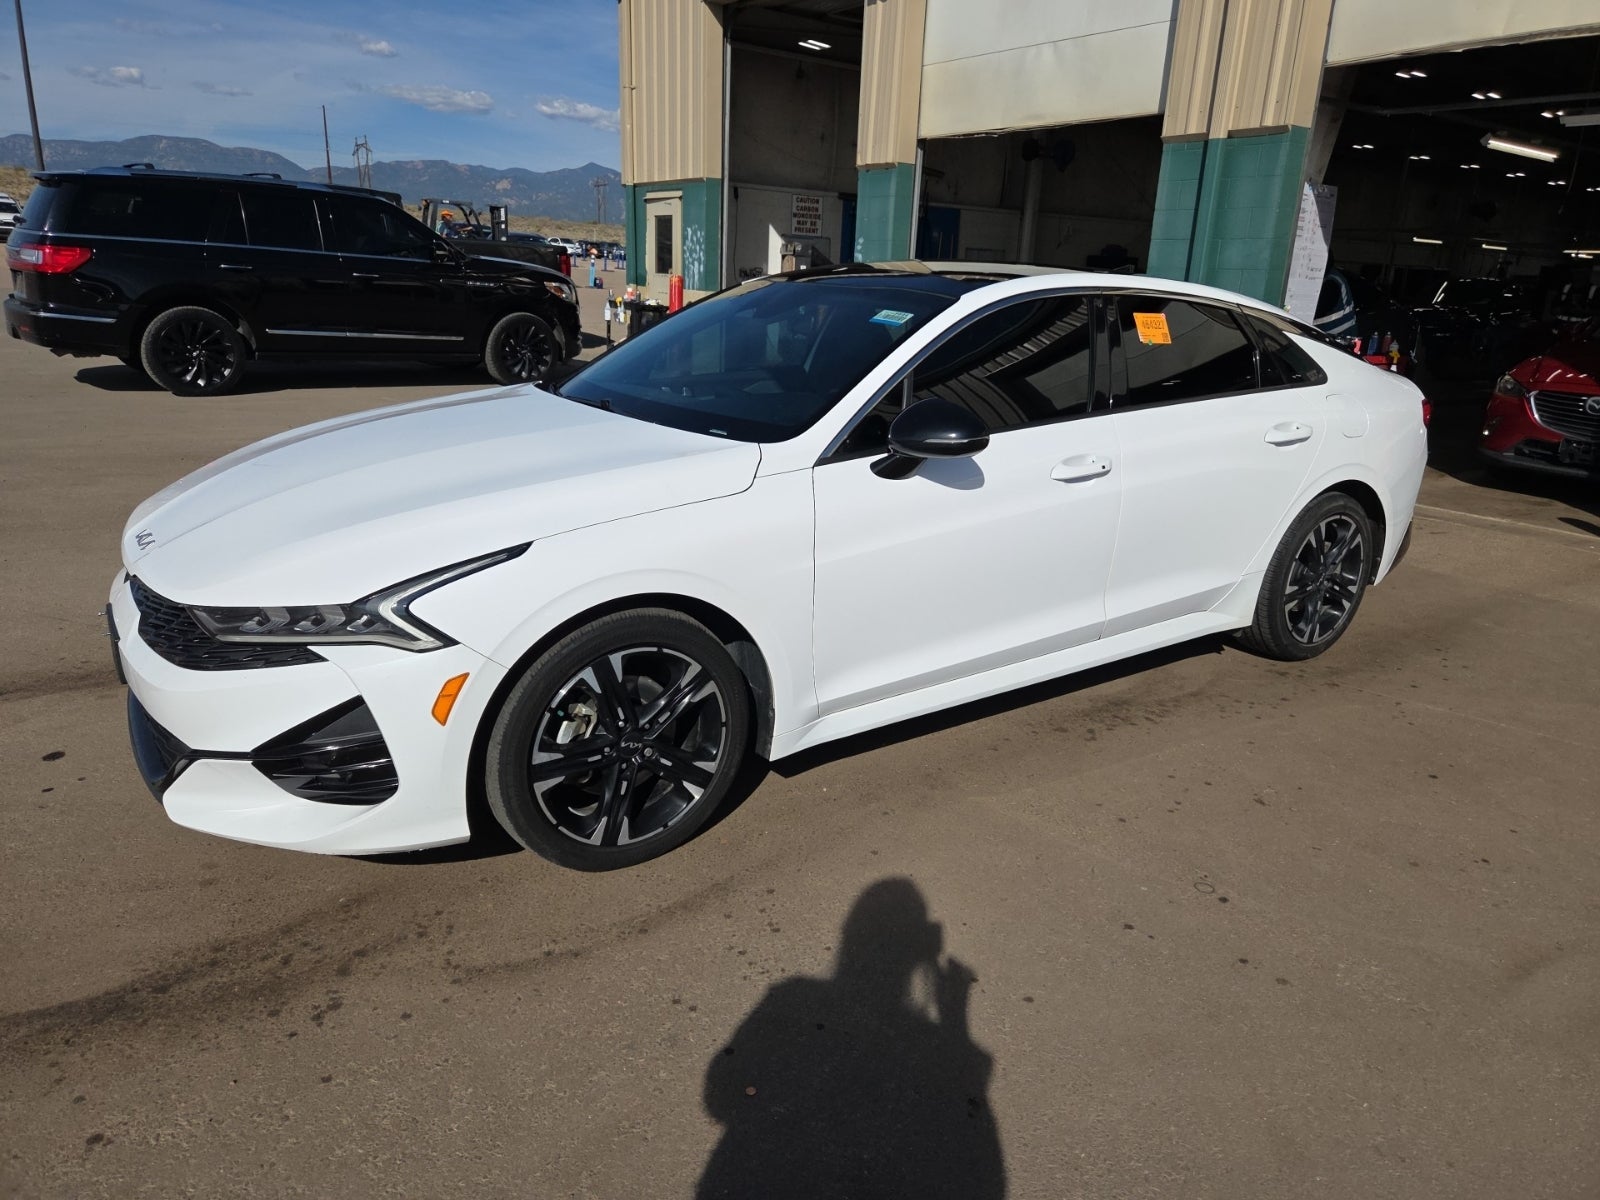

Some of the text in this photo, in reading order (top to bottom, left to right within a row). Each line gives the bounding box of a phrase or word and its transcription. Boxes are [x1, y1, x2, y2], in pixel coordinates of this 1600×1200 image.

[796, 196, 819, 204] CAUTION
[796, 205, 819, 213] CARBON
[793, 212, 821, 220] MONOXIDE
[794, 226, 818, 234] PRESENT
